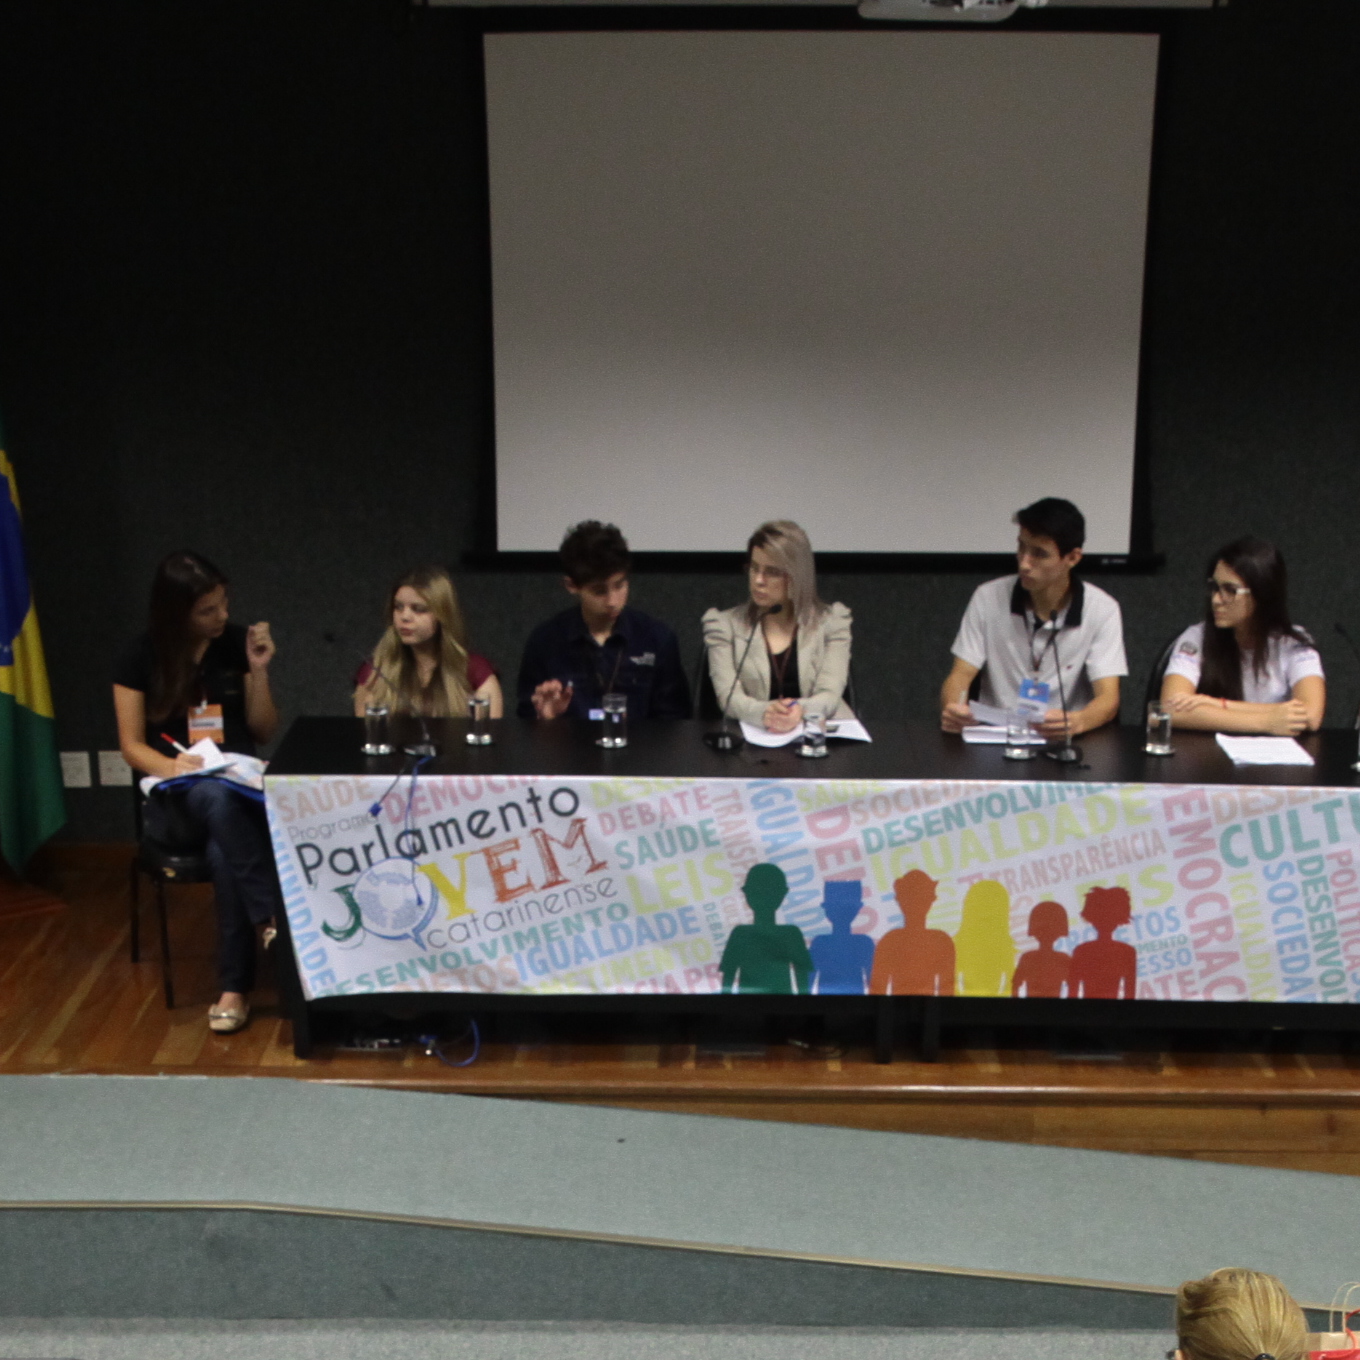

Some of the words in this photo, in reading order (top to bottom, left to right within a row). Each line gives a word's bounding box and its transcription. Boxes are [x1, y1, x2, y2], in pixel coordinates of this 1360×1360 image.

[294, 785, 582, 886] Parlamento
[597, 785, 712, 836] DEBATE
[614, 818, 720, 870] SAÚDE
[869, 784, 1152, 893] IGUALDADE
[320, 817, 609, 944] JOVEM
[426, 876, 619, 950] catarinense
[625, 852, 735, 915] LEIS
[315, 902, 630, 998] ESENVOLVIMENTO
[514, 905, 701, 981] IGUALDADE
